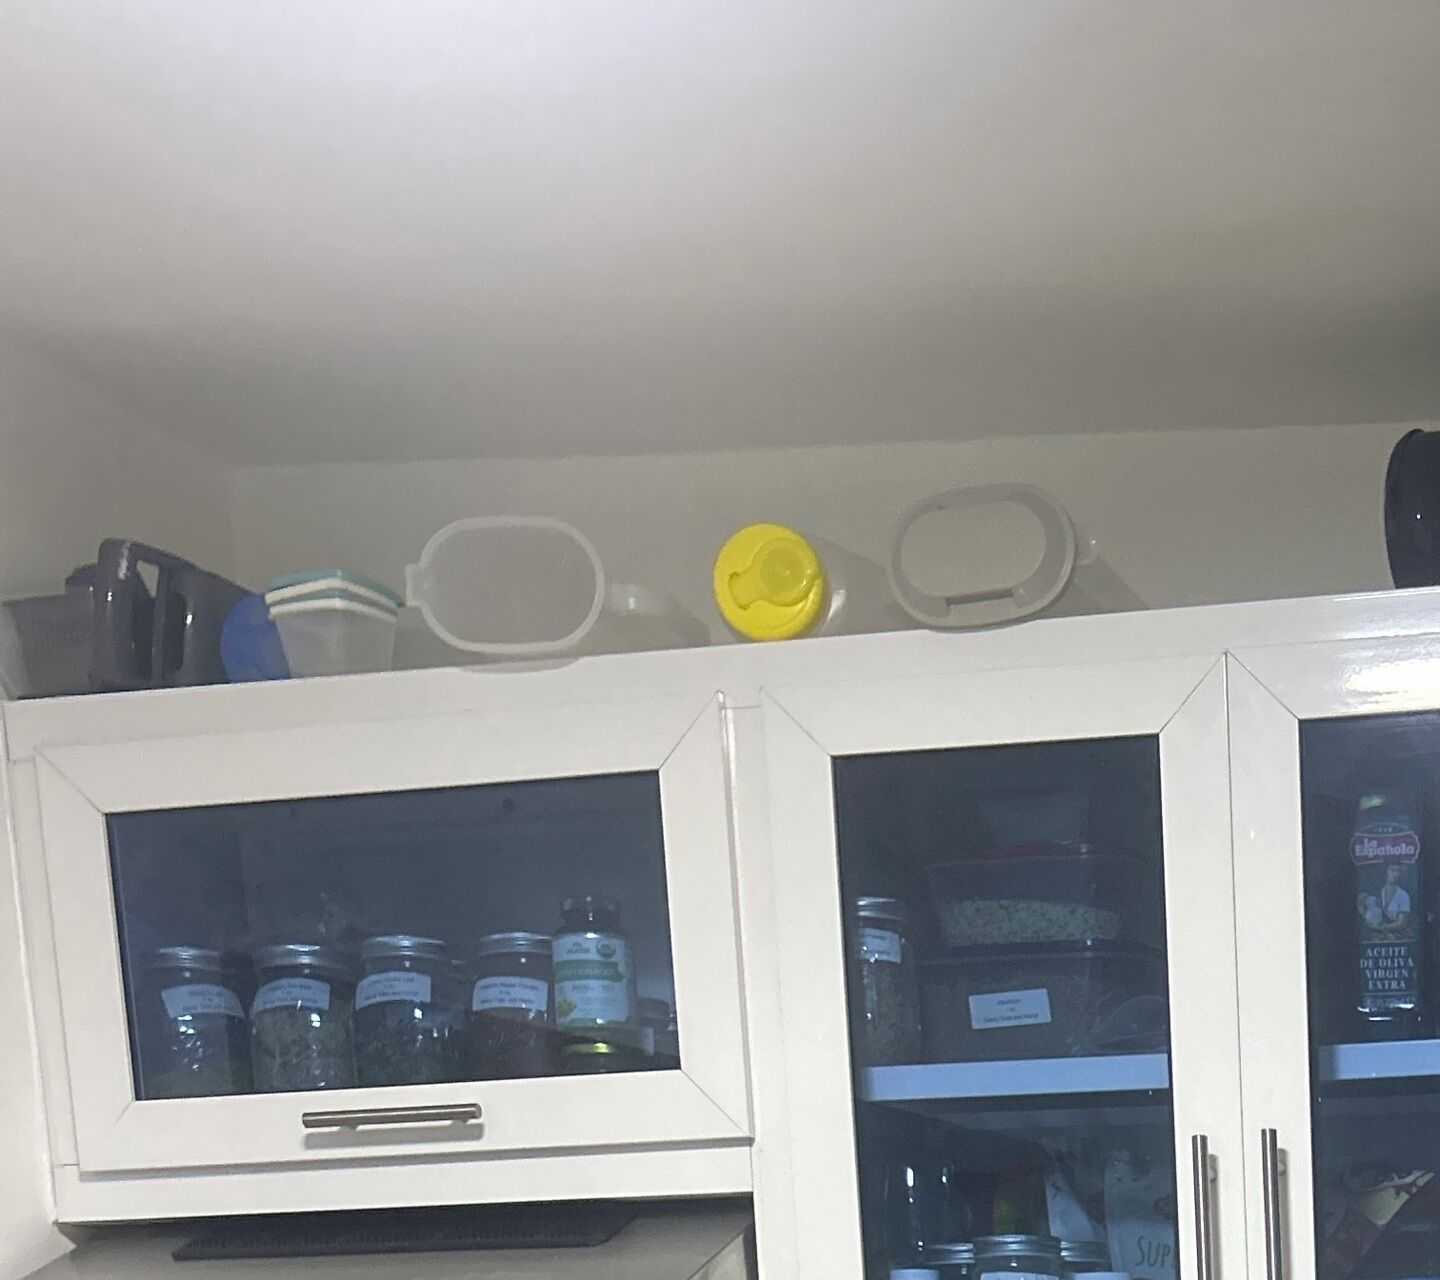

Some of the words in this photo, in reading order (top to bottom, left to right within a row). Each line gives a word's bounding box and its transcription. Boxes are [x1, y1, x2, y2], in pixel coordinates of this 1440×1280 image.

[1366, 946, 1408, 957] ACEITE
[1360, 959, 1374, 969] DE
[1379, 956, 1414, 968] OLIVA
[1365, 968, 1409, 979] VIRGEN
[1368, 979, 1406, 990] EXTRA
[1135, 1236, 1173, 1270] SUP
